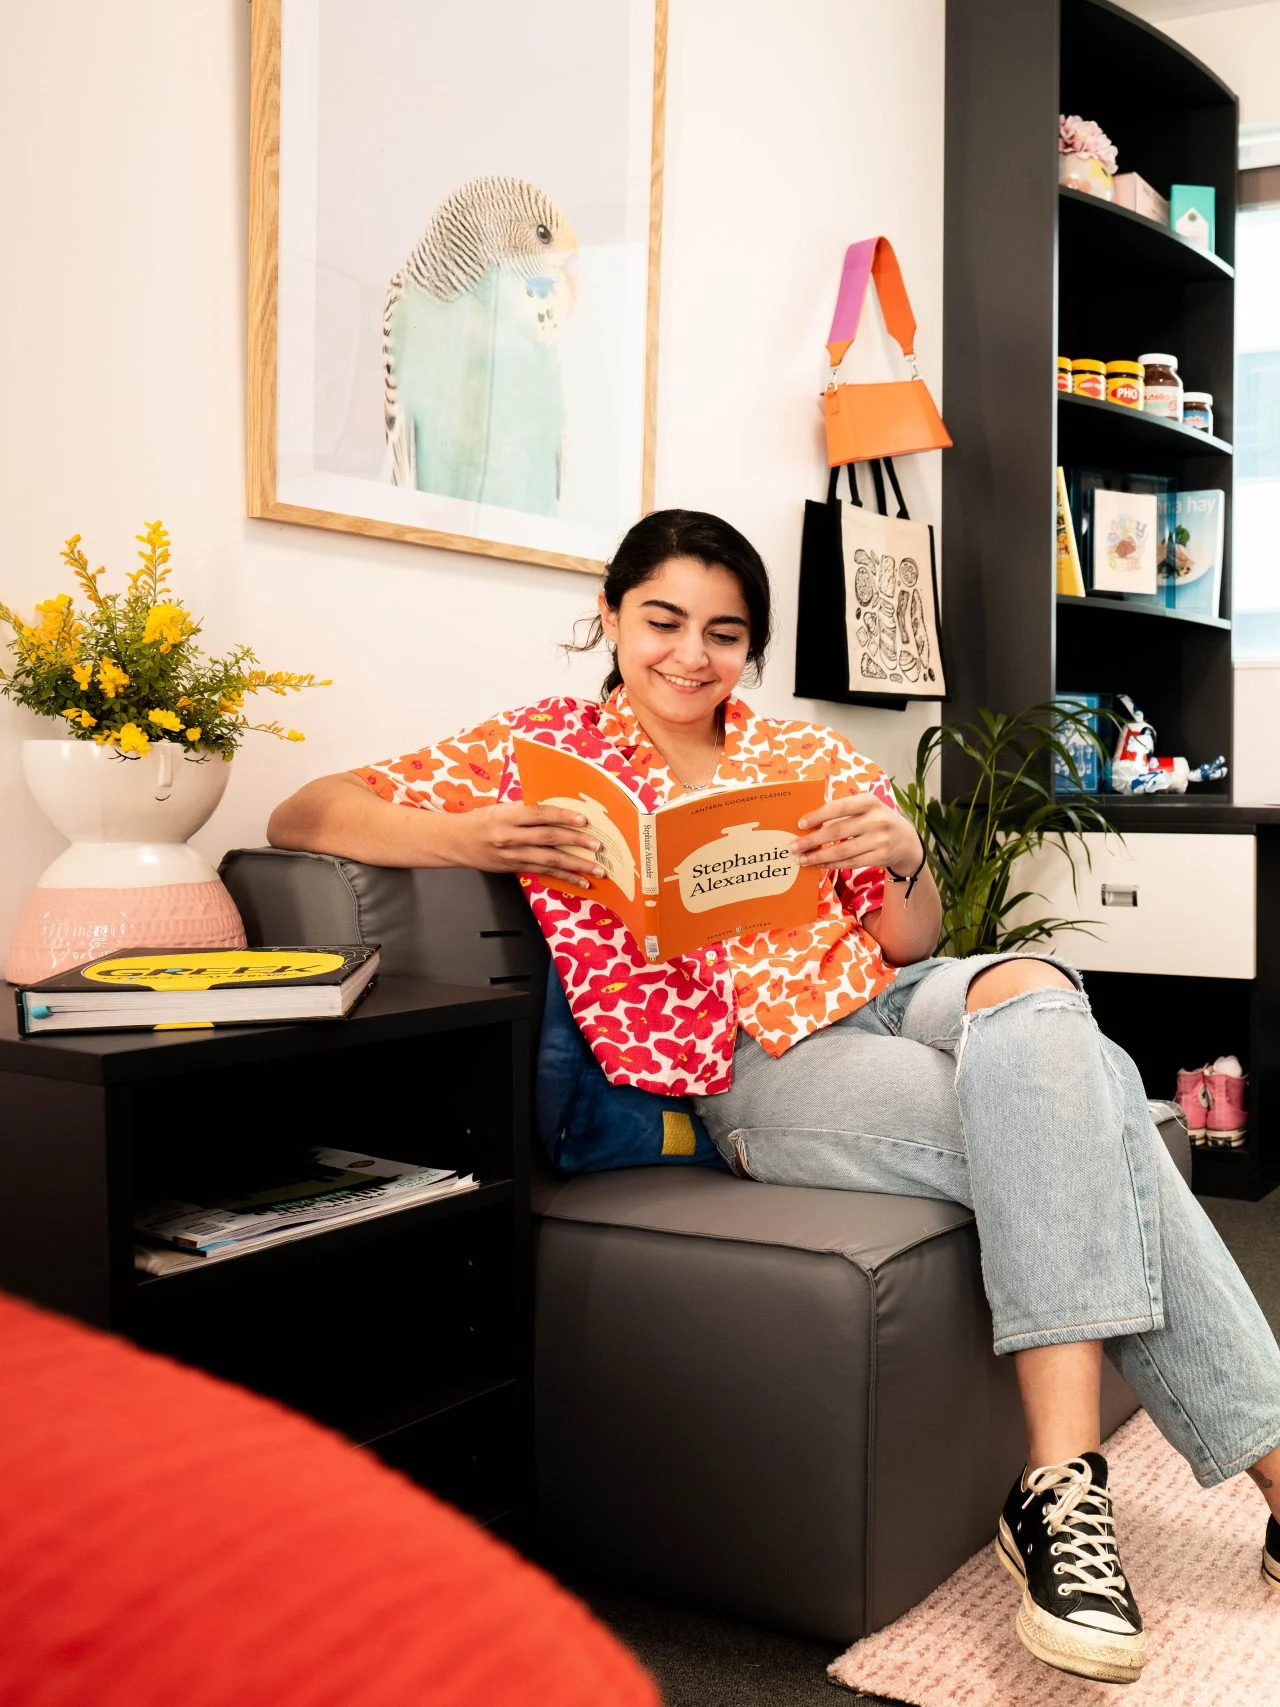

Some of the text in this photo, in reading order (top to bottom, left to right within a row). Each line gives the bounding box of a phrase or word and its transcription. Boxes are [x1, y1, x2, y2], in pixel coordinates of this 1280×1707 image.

[1116, 387, 1138, 399] PHO
[1187, 496, 1217, 516] hay
[691, 791, 792, 815] LANTERN COOKERY CLASSICS
[643, 824, 652, 852] Stephanie
[645, 852, 654, 879] Alexander
[692, 847, 790, 879] Stephanie
[690, 865, 792, 898] Alexander
[96, 964, 325, 977] GREEK
